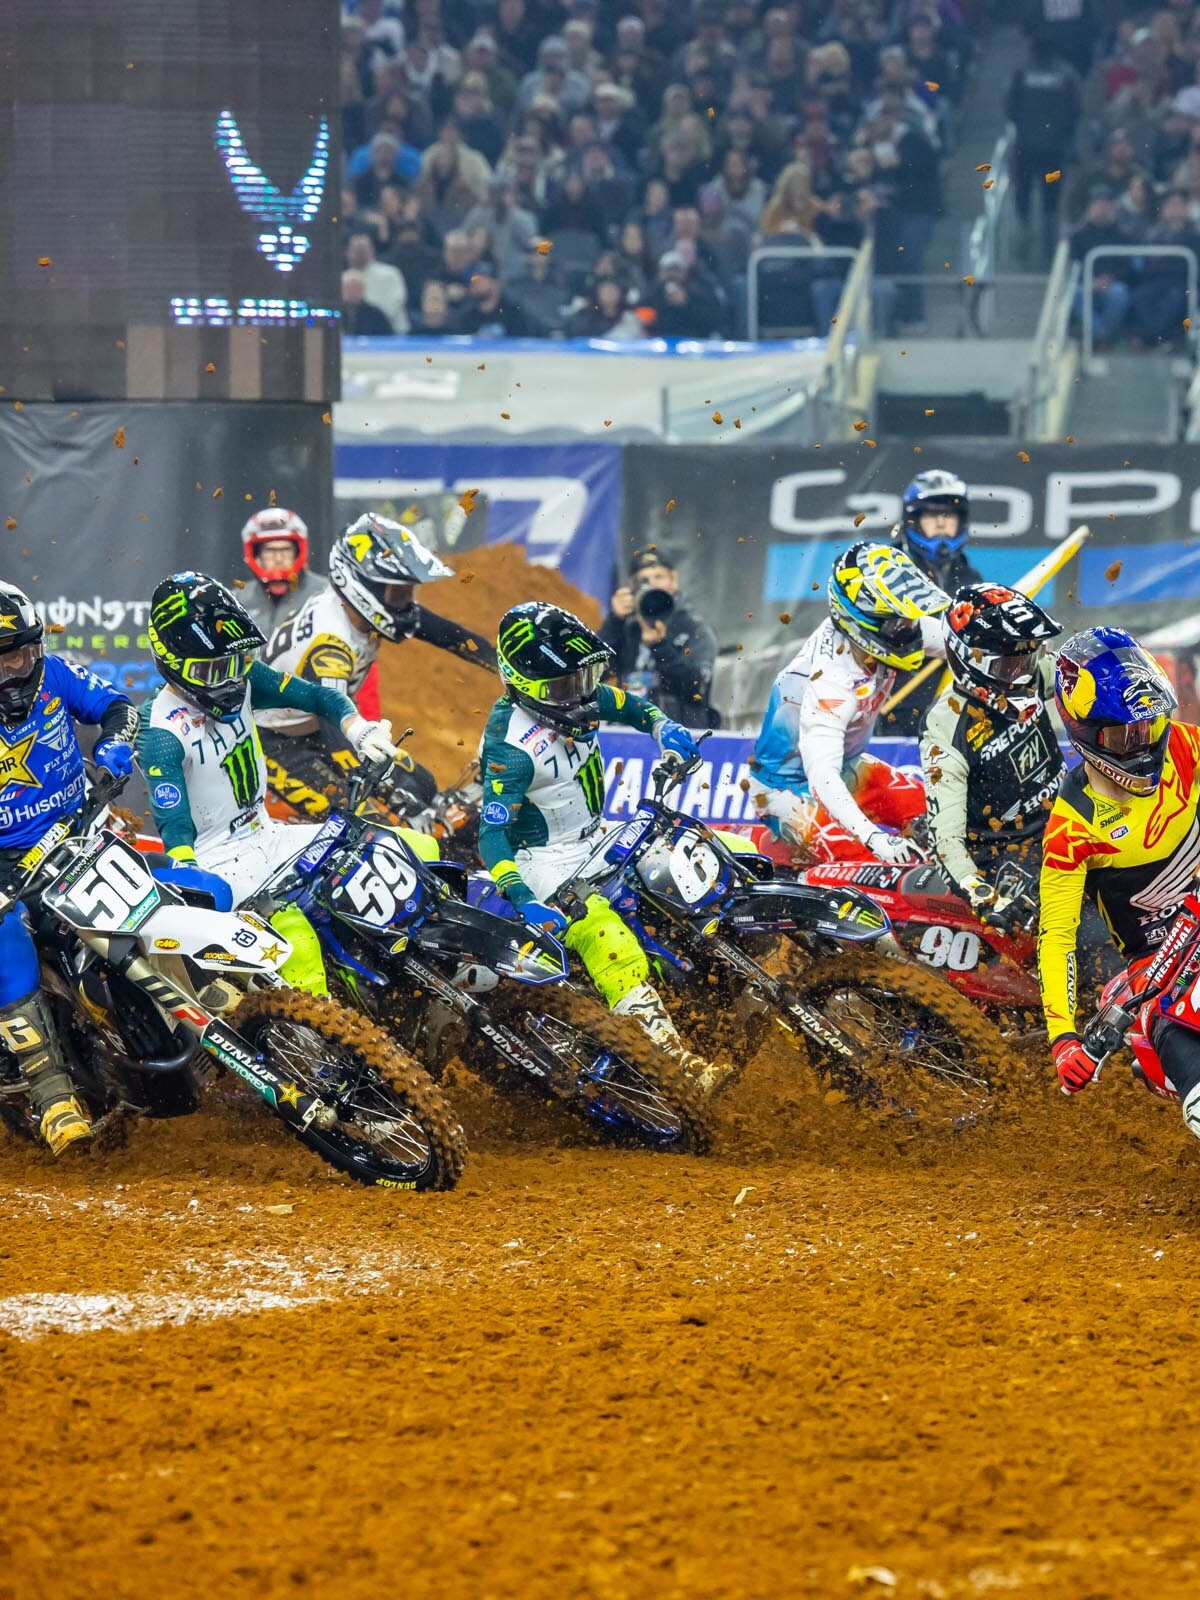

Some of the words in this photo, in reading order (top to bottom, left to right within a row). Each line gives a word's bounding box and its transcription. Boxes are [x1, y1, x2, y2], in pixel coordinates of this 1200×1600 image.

[48, 633, 151, 650] ENERG
[14, 771, 88, 823] Husqvarn
[66, 844, 155, 929] 50
[344, 836, 418, 927] 59
[670, 829, 720, 904] 6
[918, 925, 981, 971] 90
[207, 1031, 279, 1085] DUNLOP
[216, 1052, 268, 1095] MOTOREX
